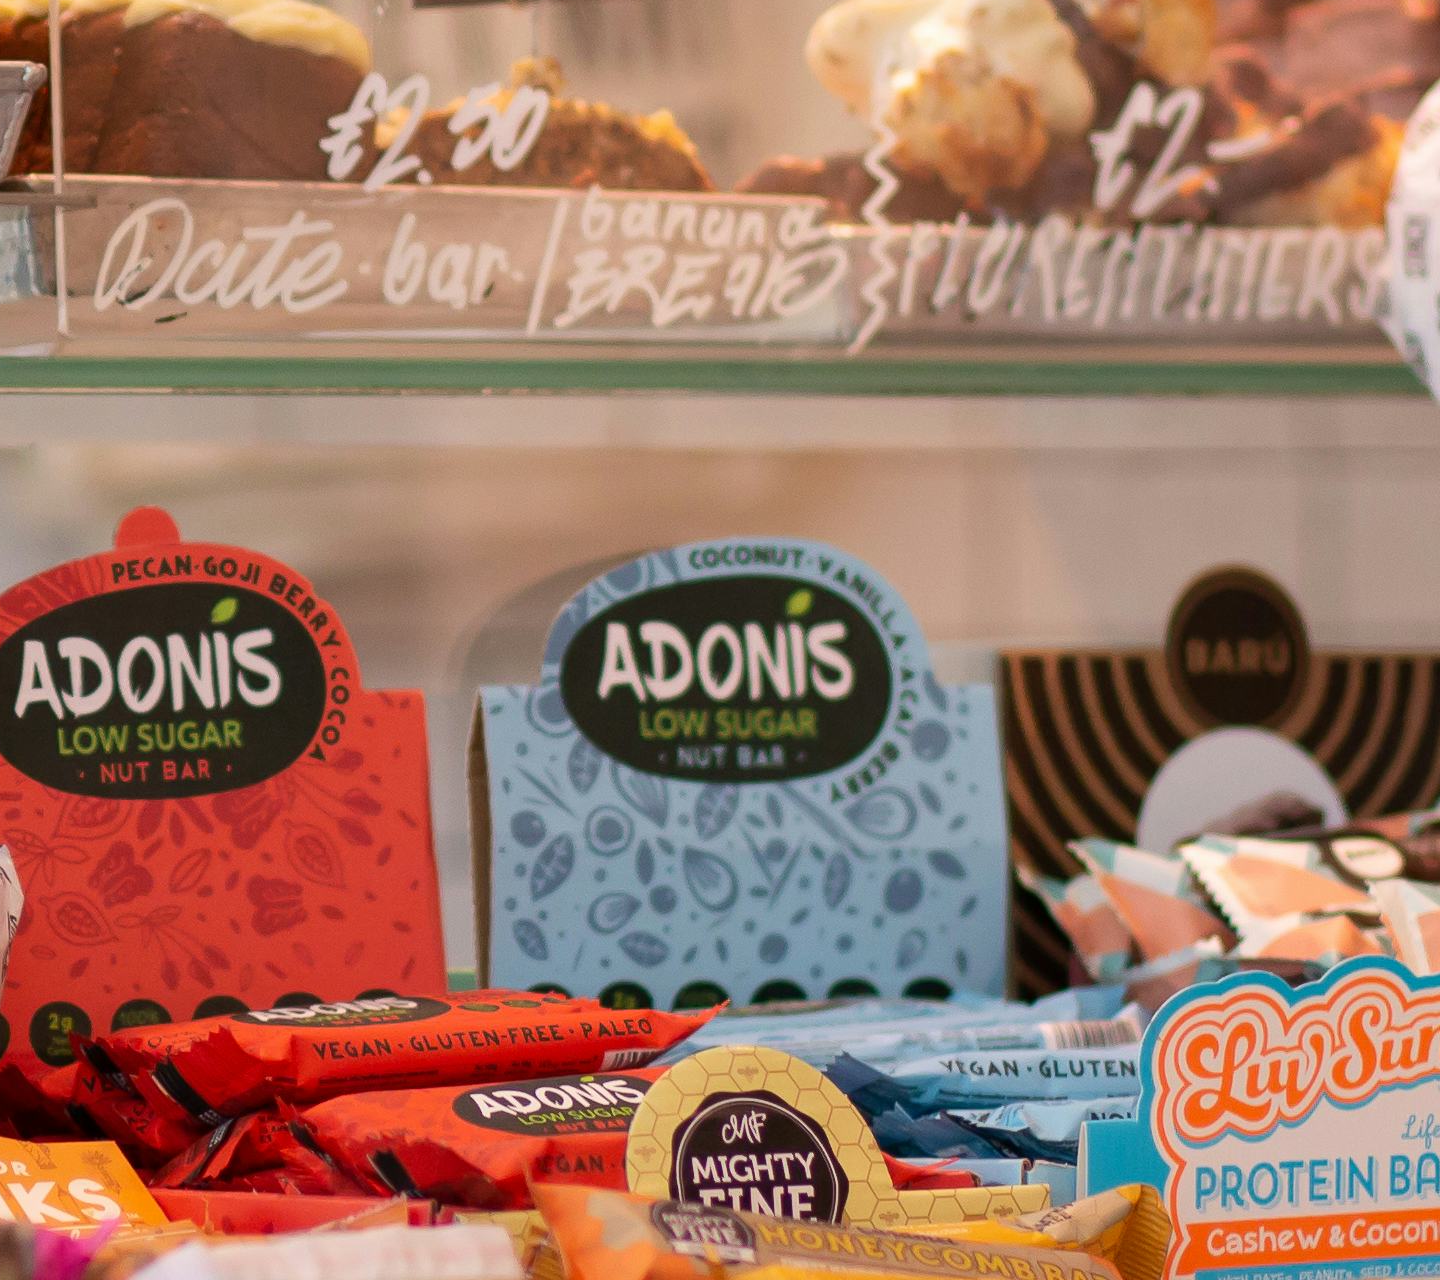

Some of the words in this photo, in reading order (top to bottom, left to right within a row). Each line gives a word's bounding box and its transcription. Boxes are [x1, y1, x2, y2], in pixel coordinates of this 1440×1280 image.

[688, 544, 805, 571] COCONUT
[111, 554, 193, 584] PECAN
[203, 556, 261, 586] GOJI
[268, 573, 342, 649] BERRY
[14, 626, 282, 722] ADONIS
[598, 620, 855, 703] ADONIS
[57, 726, 129, 756] LOW
[136, 720, 243, 752] SUGAR
[639, 708, 710, 740] LOW
[715, 707, 819, 739] SUGAR
[99, 761, 149, 785] NUT
[161, 758, 212, 782] BAR
[677, 744, 729, 767] NUT
[736, 744, 785, 767] BAR
[313, 1039, 393, 1062] VEGAN
[410, 1024, 565, 1054] GLUTEN-FREE
[580, 1016, 654, 1039] PALEO
[468, 1078, 647, 1121] ADONIS
[690, 1151, 816, 1187] MIGHTY
[1194, 1153, 1376, 1211] PROTEIN
[1206, 1222, 1324, 1257] Cashew
[1329, 1222, 1346, 1248] &
